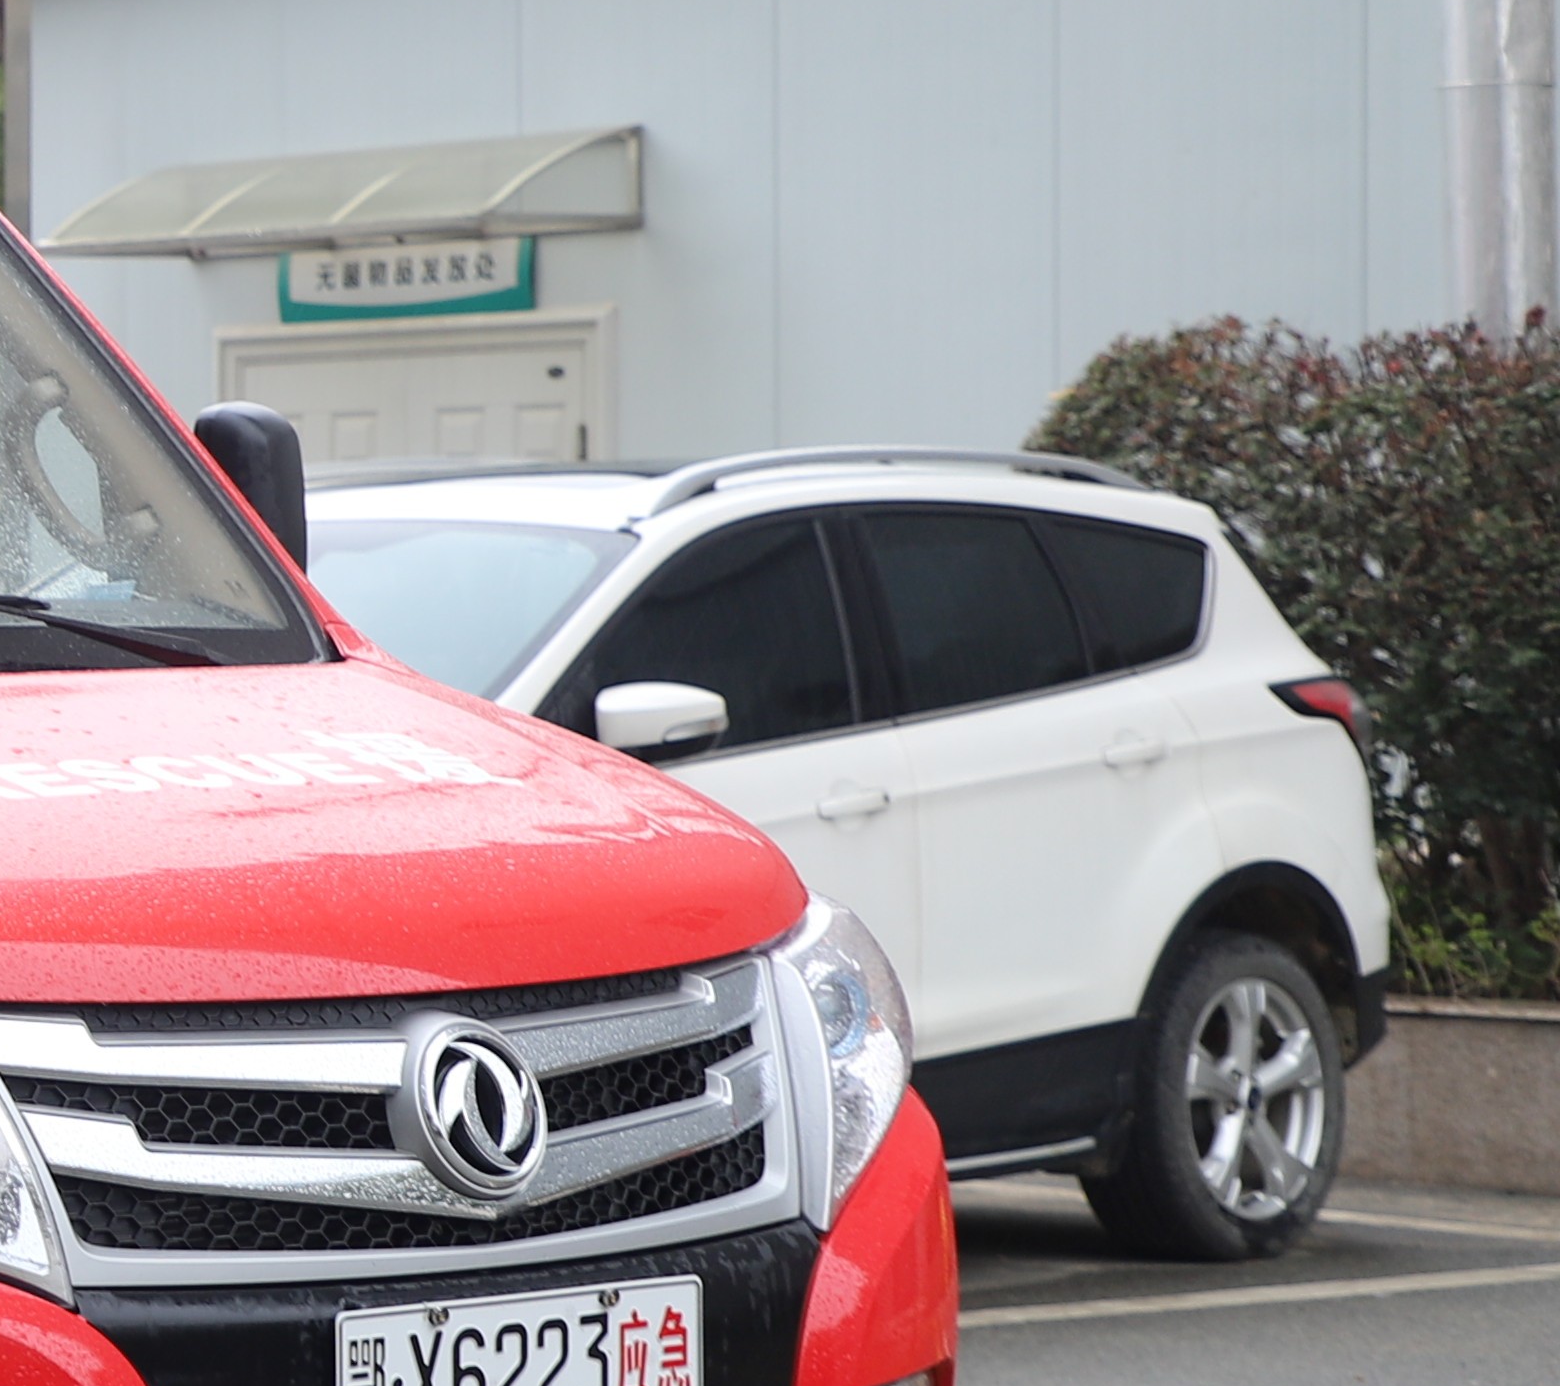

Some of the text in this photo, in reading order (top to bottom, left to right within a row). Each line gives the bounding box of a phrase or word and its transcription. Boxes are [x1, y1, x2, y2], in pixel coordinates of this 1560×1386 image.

[316, 253, 497, 291] 无菌物品发放处
